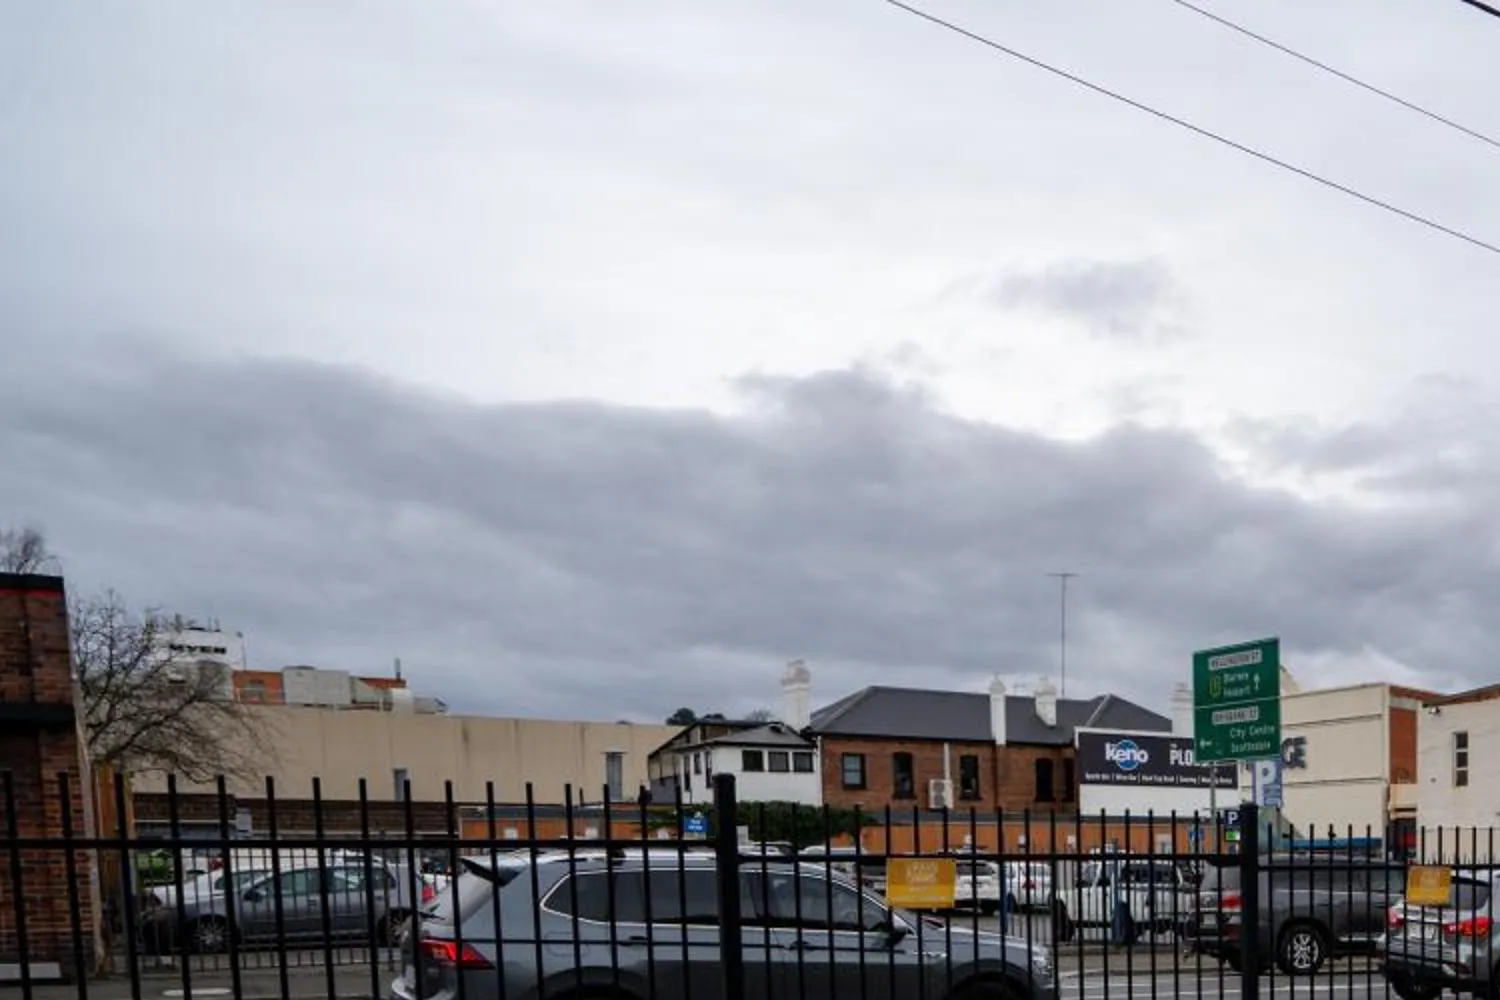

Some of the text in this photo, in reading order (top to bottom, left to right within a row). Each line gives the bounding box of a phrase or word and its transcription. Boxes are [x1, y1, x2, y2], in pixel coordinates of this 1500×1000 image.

[1229, 724, 1275, 740] City Centre
[1104, 741, 1149, 763] Keno
[1255, 760, 1277, 807] P
[1227, 811, 1239, 825] P
